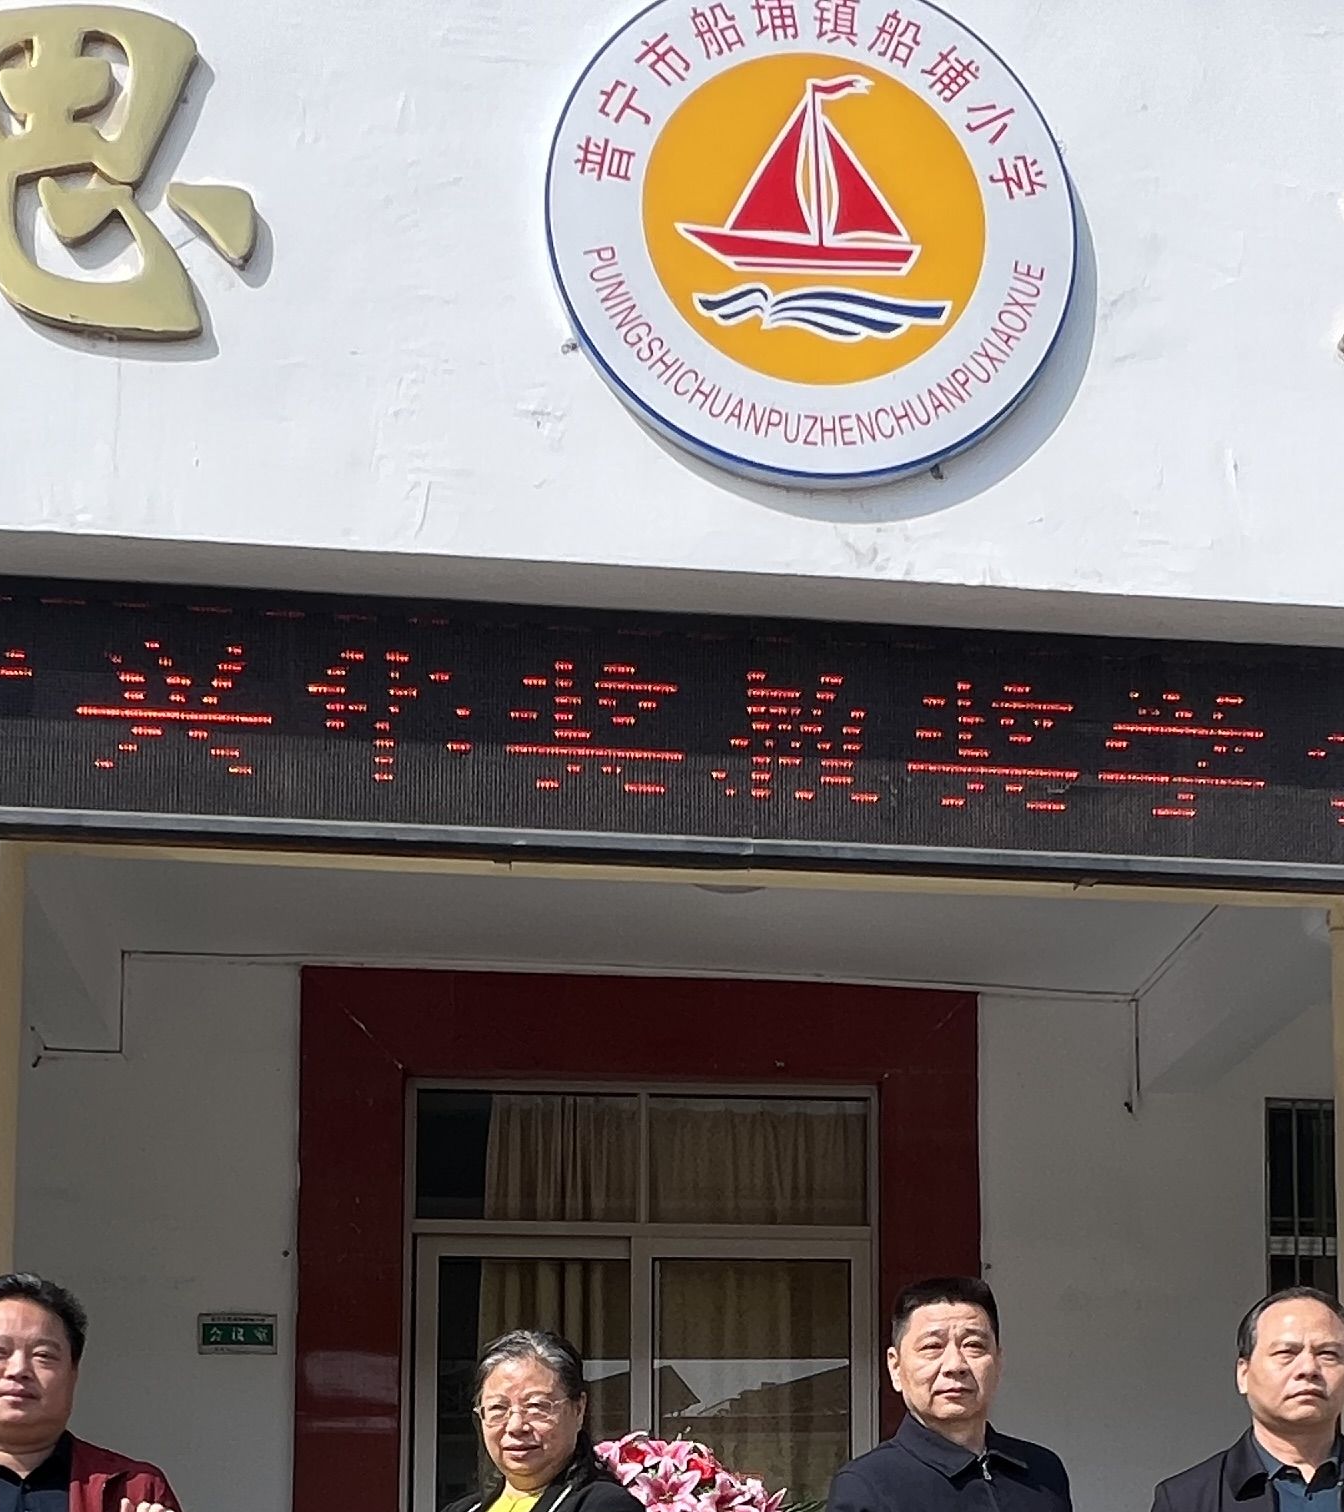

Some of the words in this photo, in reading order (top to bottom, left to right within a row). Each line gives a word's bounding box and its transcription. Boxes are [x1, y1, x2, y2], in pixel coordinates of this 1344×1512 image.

[574, 0, 1048, 200] 普宁市船埔镇船埔小学
